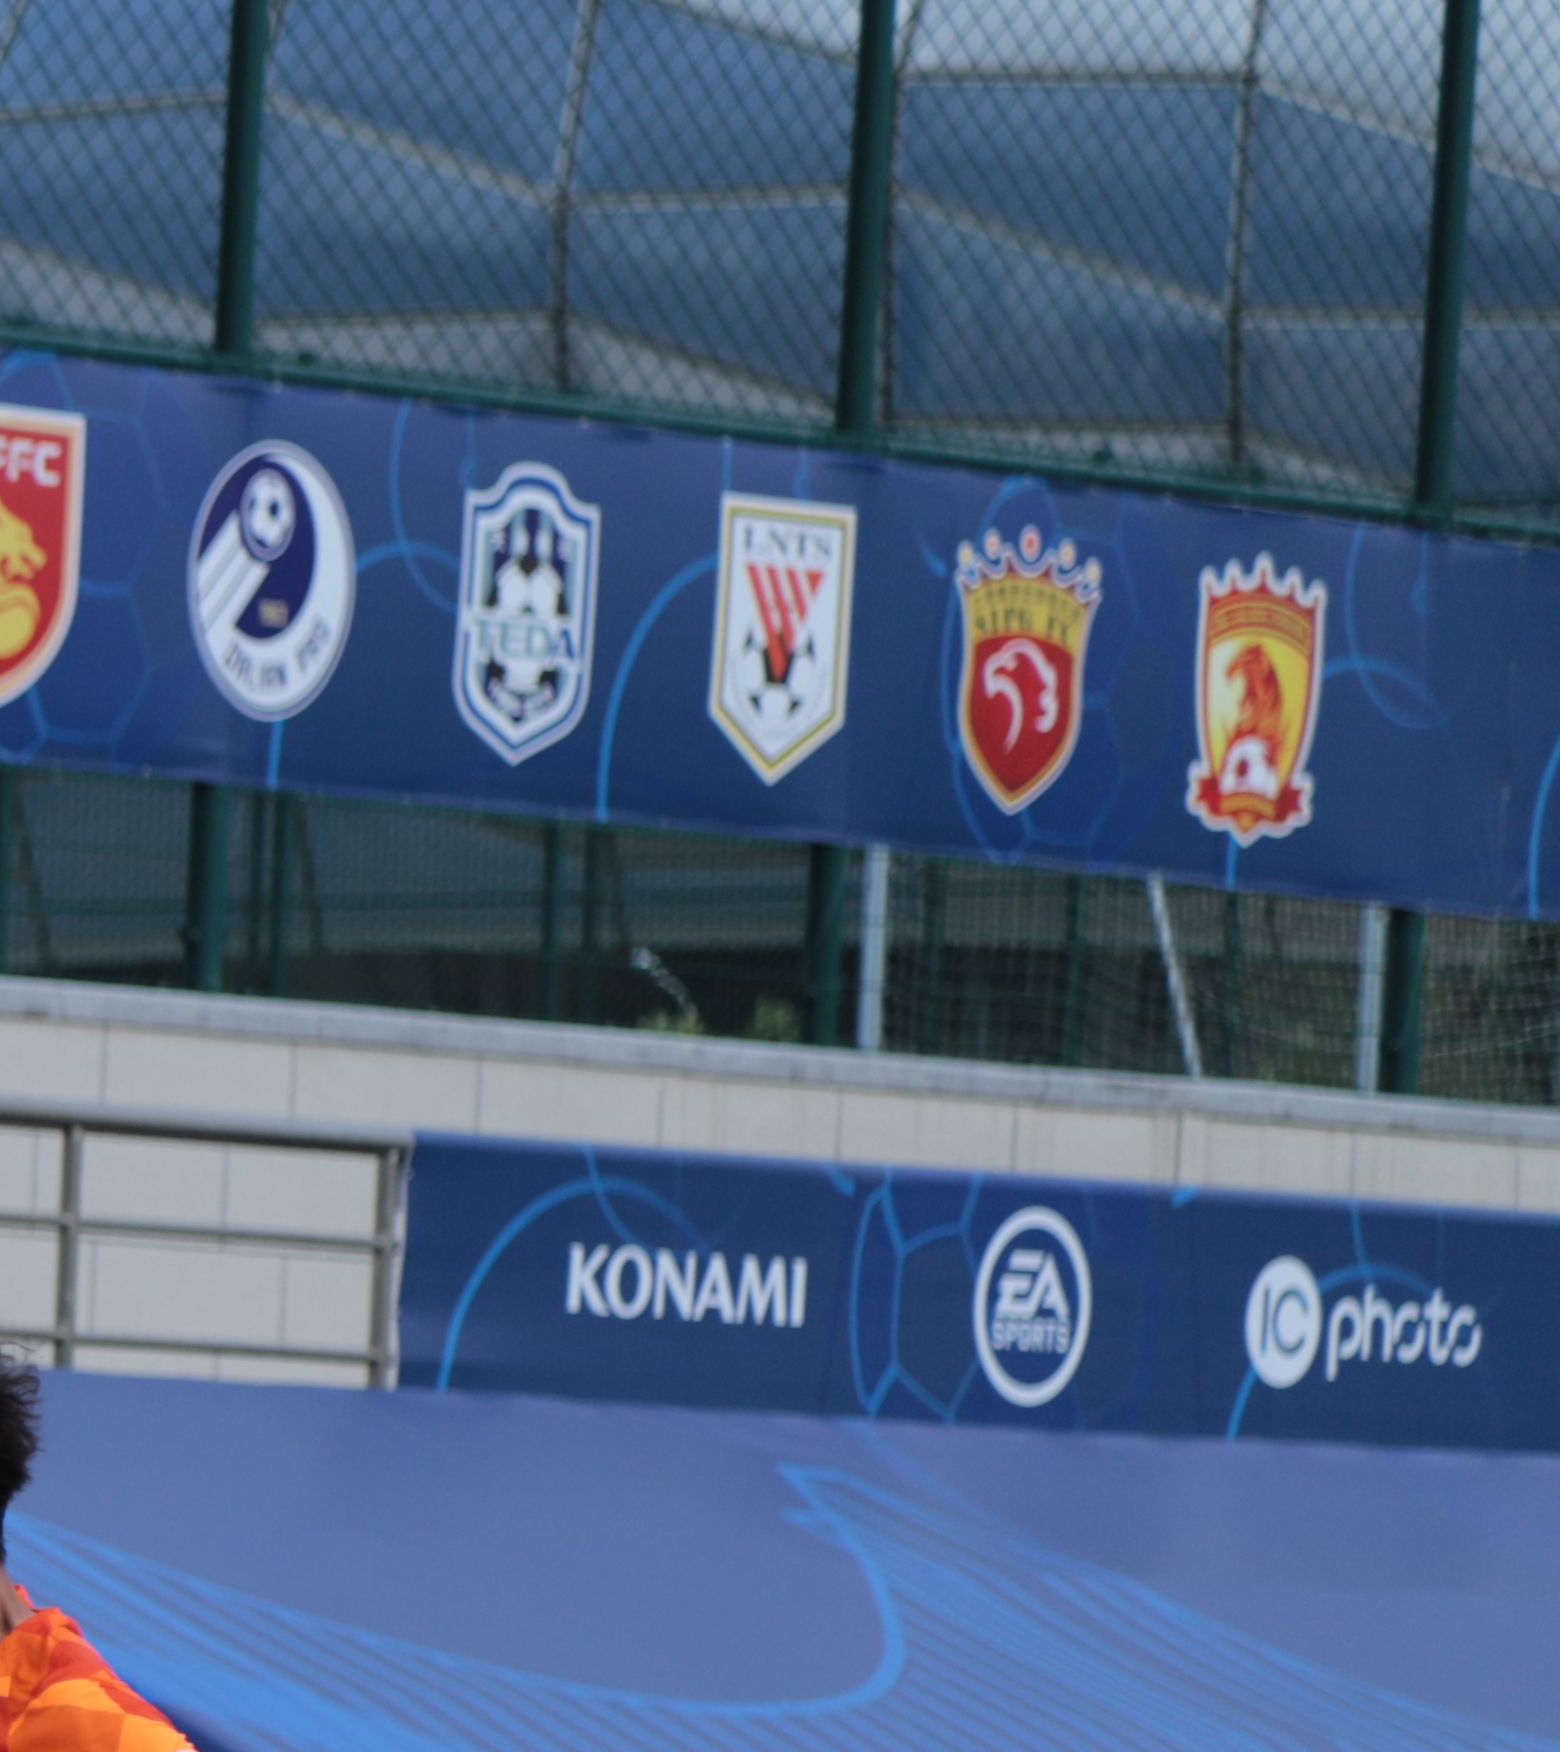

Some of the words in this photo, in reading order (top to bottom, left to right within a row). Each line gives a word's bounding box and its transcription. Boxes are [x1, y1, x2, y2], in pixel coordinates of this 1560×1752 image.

[566, 1241, 808, 1328] KONAMI
[996, 1249, 1069, 1319] EA
[991, 1318, 1070, 1354] SPORTS
